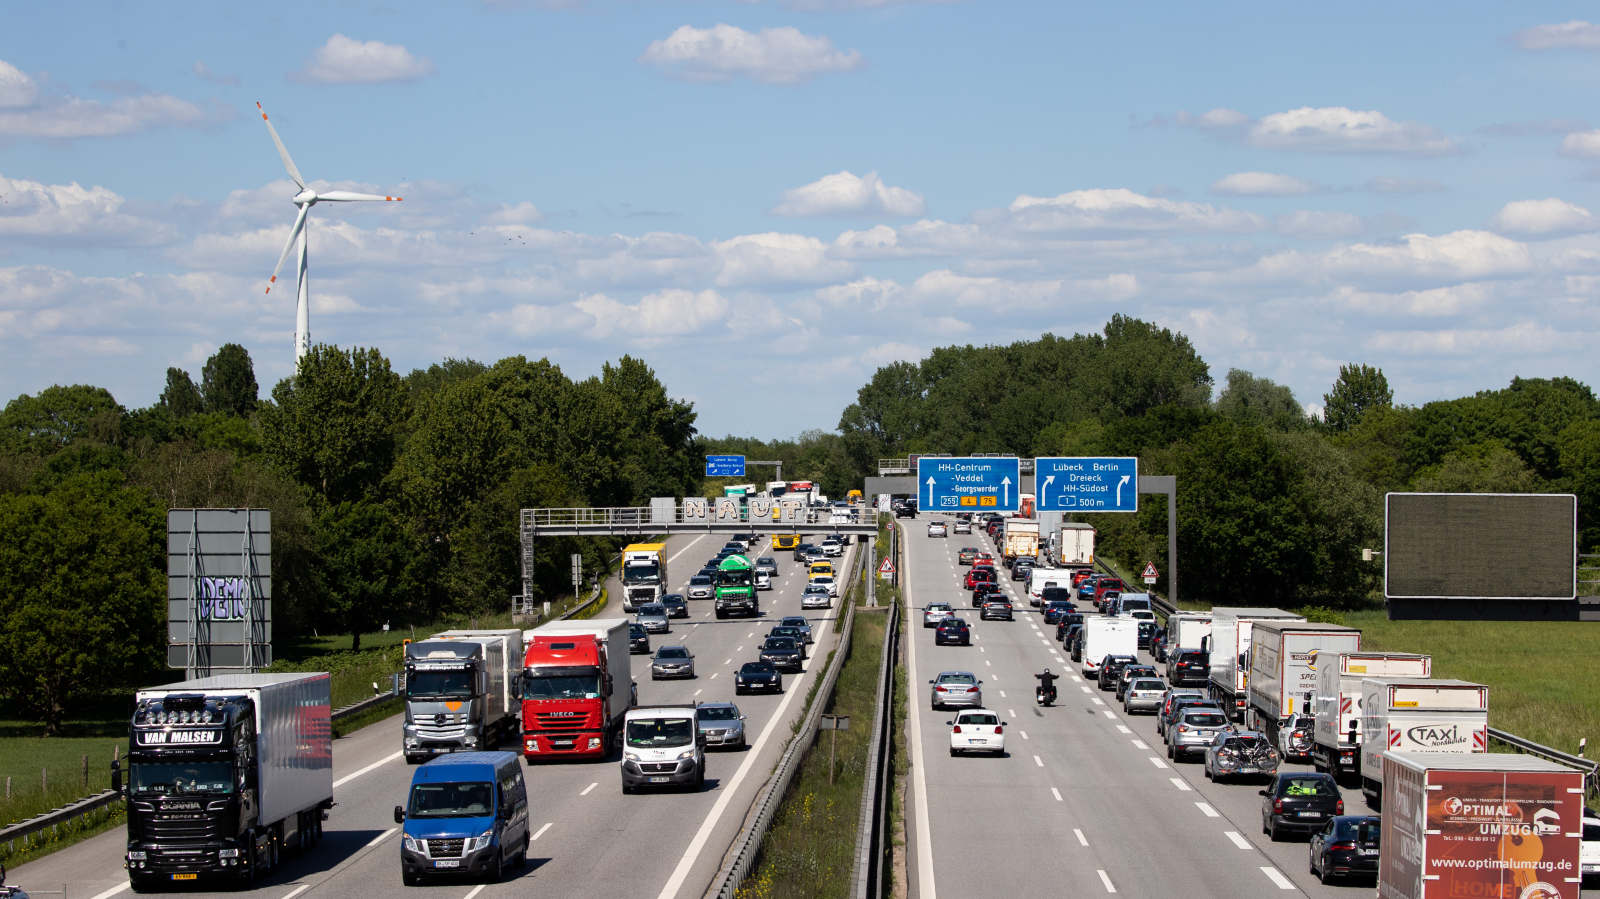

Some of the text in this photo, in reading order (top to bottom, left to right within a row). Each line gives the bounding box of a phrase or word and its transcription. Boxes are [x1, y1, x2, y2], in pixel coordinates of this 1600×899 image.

[1053, 463, 1118, 471] Lübeck Berlin
[200, 577, 250, 619] DEMO
[145, 731, 215, 744] VAN MALSEN
[1432, 736, 1467, 746] Nordheide
[1431, 858, 1572, 872] www.optimalumzug.de
[1454, 880, 1512, 898] HOME
